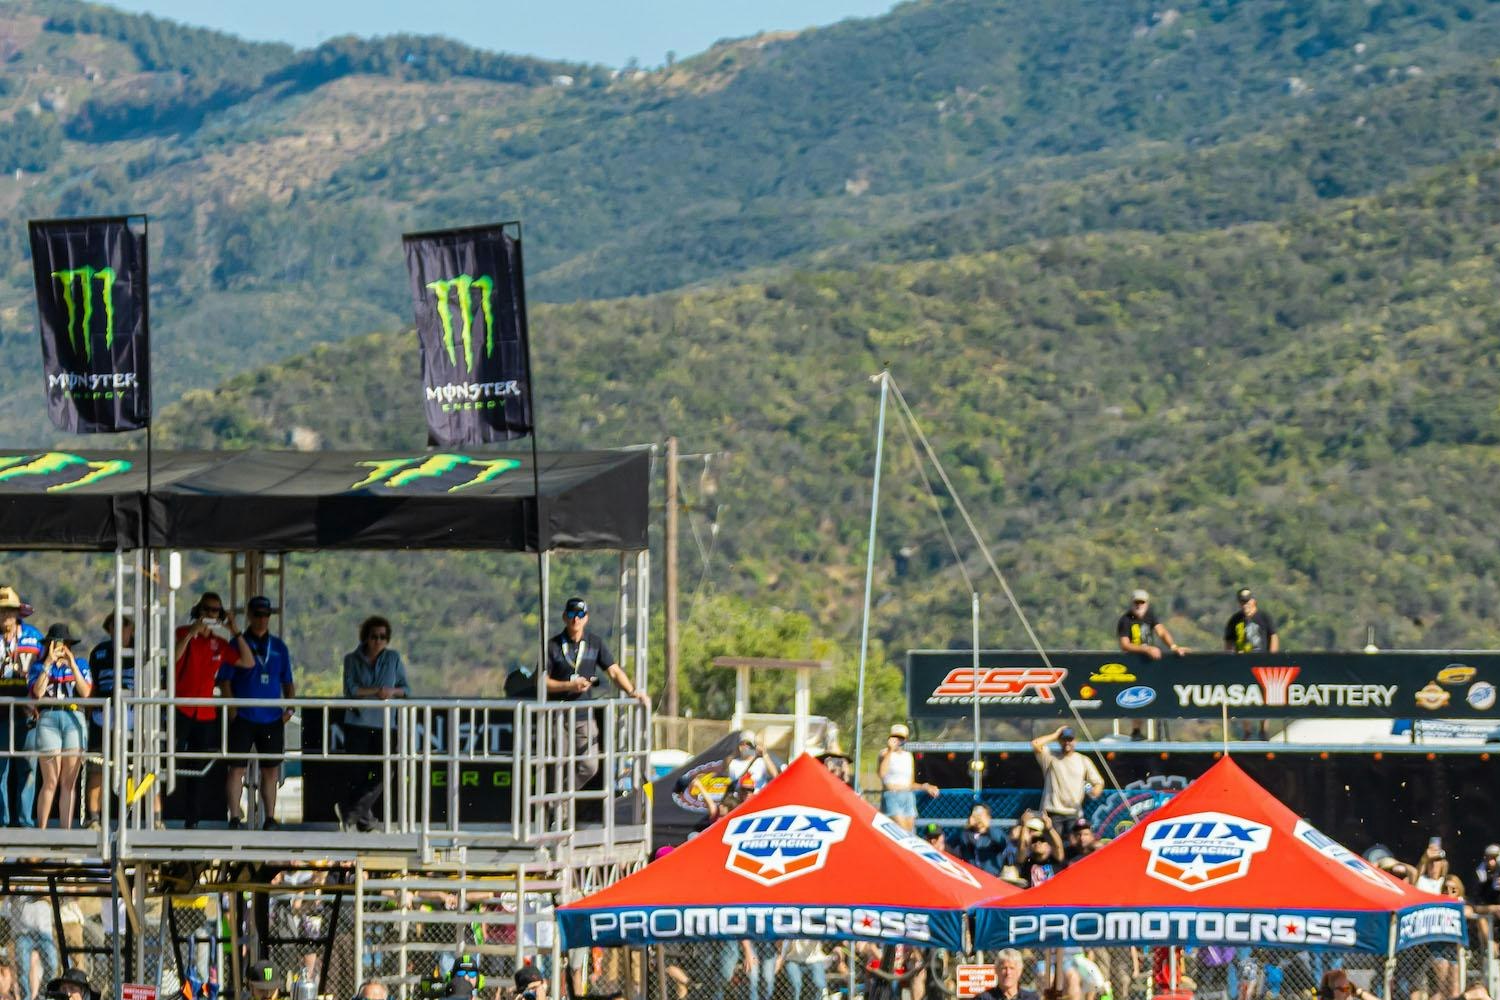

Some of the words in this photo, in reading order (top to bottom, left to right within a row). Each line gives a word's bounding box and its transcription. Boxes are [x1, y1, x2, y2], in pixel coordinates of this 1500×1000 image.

[48, 370, 138, 391] MONSTER
[426, 380, 521, 403] MONSTER
[932, 667, 1068, 703] SSR
[1173, 684, 1263, 706] YUASA
[1288, 684, 1398, 706] BATTERY
[741, 839, 769, 849] PRO
[770, 839, 820, 849] RACING
[1161, 846, 1189, 856] PRO
[1190, 846, 1241, 856] RACING
